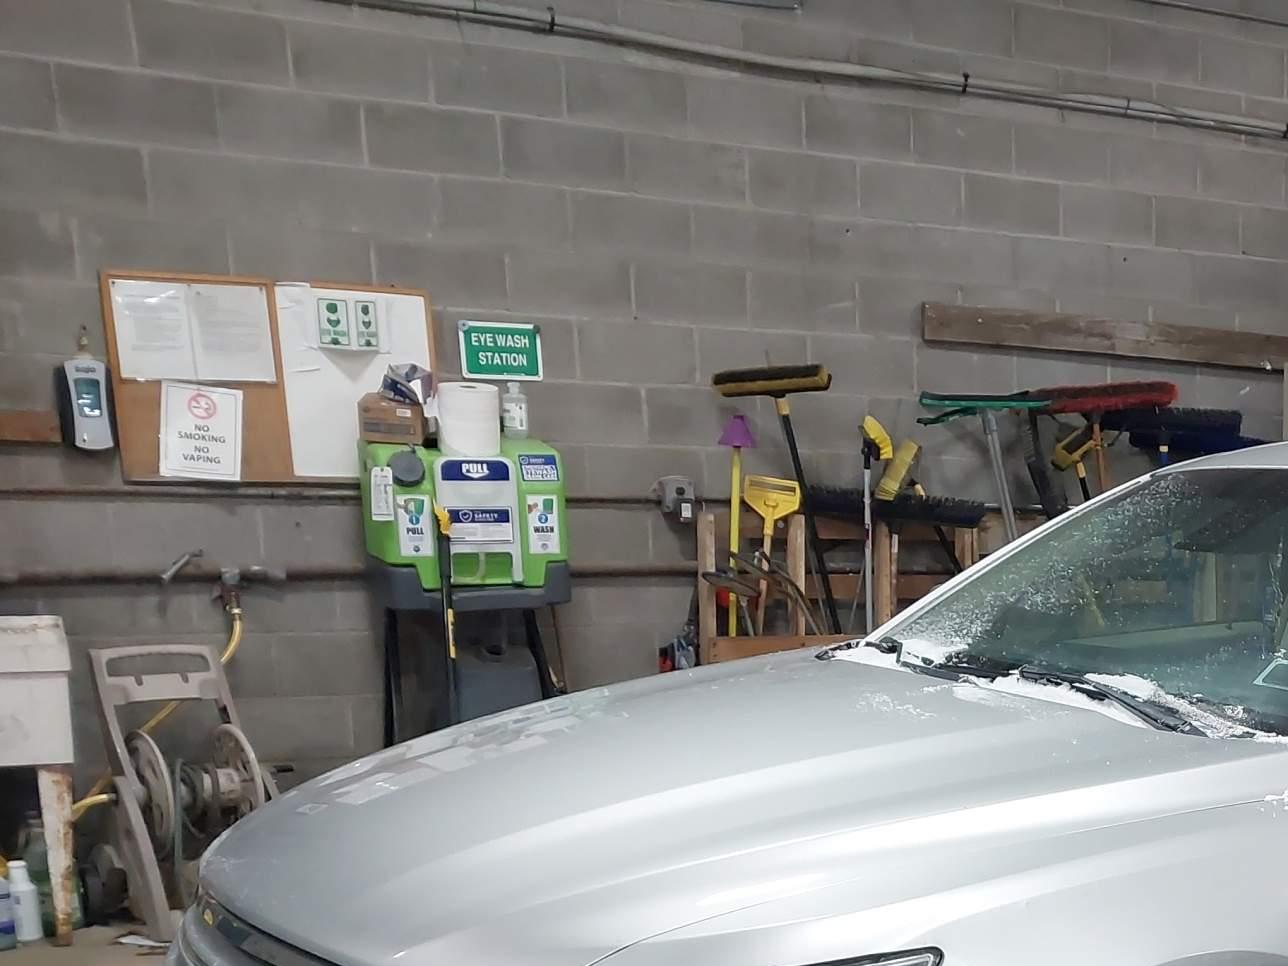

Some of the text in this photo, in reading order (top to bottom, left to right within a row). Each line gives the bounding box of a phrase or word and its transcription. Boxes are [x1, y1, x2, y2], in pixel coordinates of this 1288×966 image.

[471, 333, 529, 348] EYE WASH
[478, 352, 528, 366] STATION
[194, 424, 210, 432] NO
[178, 431, 226, 443] SMOKING
[194, 445, 210, 454] NO
[182, 453, 221, 464] VAPING
[462, 463, 489, 473] PULL
[406, 527, 424, 535] PULL
